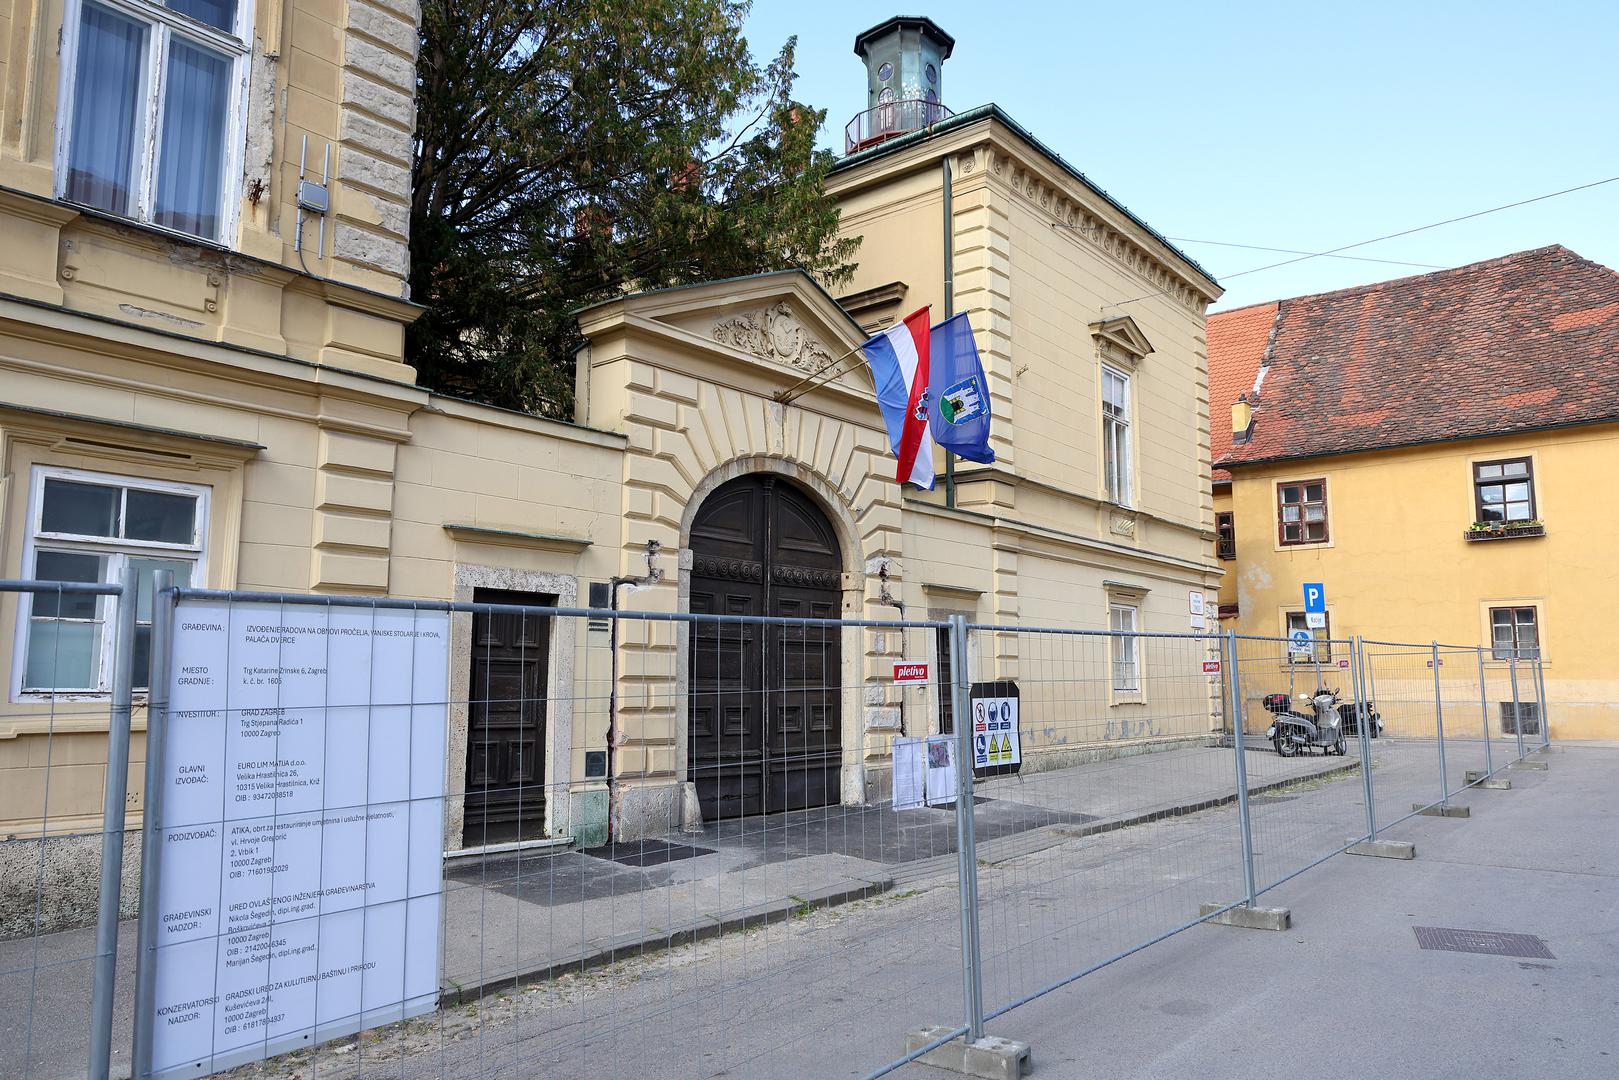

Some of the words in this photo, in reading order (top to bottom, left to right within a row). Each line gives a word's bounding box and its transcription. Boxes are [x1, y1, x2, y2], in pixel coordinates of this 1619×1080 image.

[1309, 588, 1318, 606] P
[281, 626, 306, 634] RADOVA
[244, 667, 253, 675] Trg
[898, 666, 924, 678] pletivo
[261, 708, 285, 716] ZAGREB
[241, 720, 250, 728] Trg
[251, 720, 277, 728] Stjepana
[178, 766, 205, 774] GLAVNI
[238, 762, 256, 770] EURO
[236, 783, 255, 791] 10315
[256, 781, 274, 790] Velika
[240, 836, 260, 845] Hrvoje
[231, 860, 250, 868] 10000
[250, 857, 272, 866] Zagreb
[229, 903, 248, 912] URED
[163, 908, 212, 922] GRAĐEVINSKI
[229, 915, 249, 923] Nikola
[228, 935, 248, 945] 10000
[248, 932, 269, 942] Zagreb
[225, 989, 254, 1001] GRADSKI
[255, 984, 274, 995] URED
[225, 1013, 244, 1023] 10000
[245, 1009, 266, 1019] Zagreb
